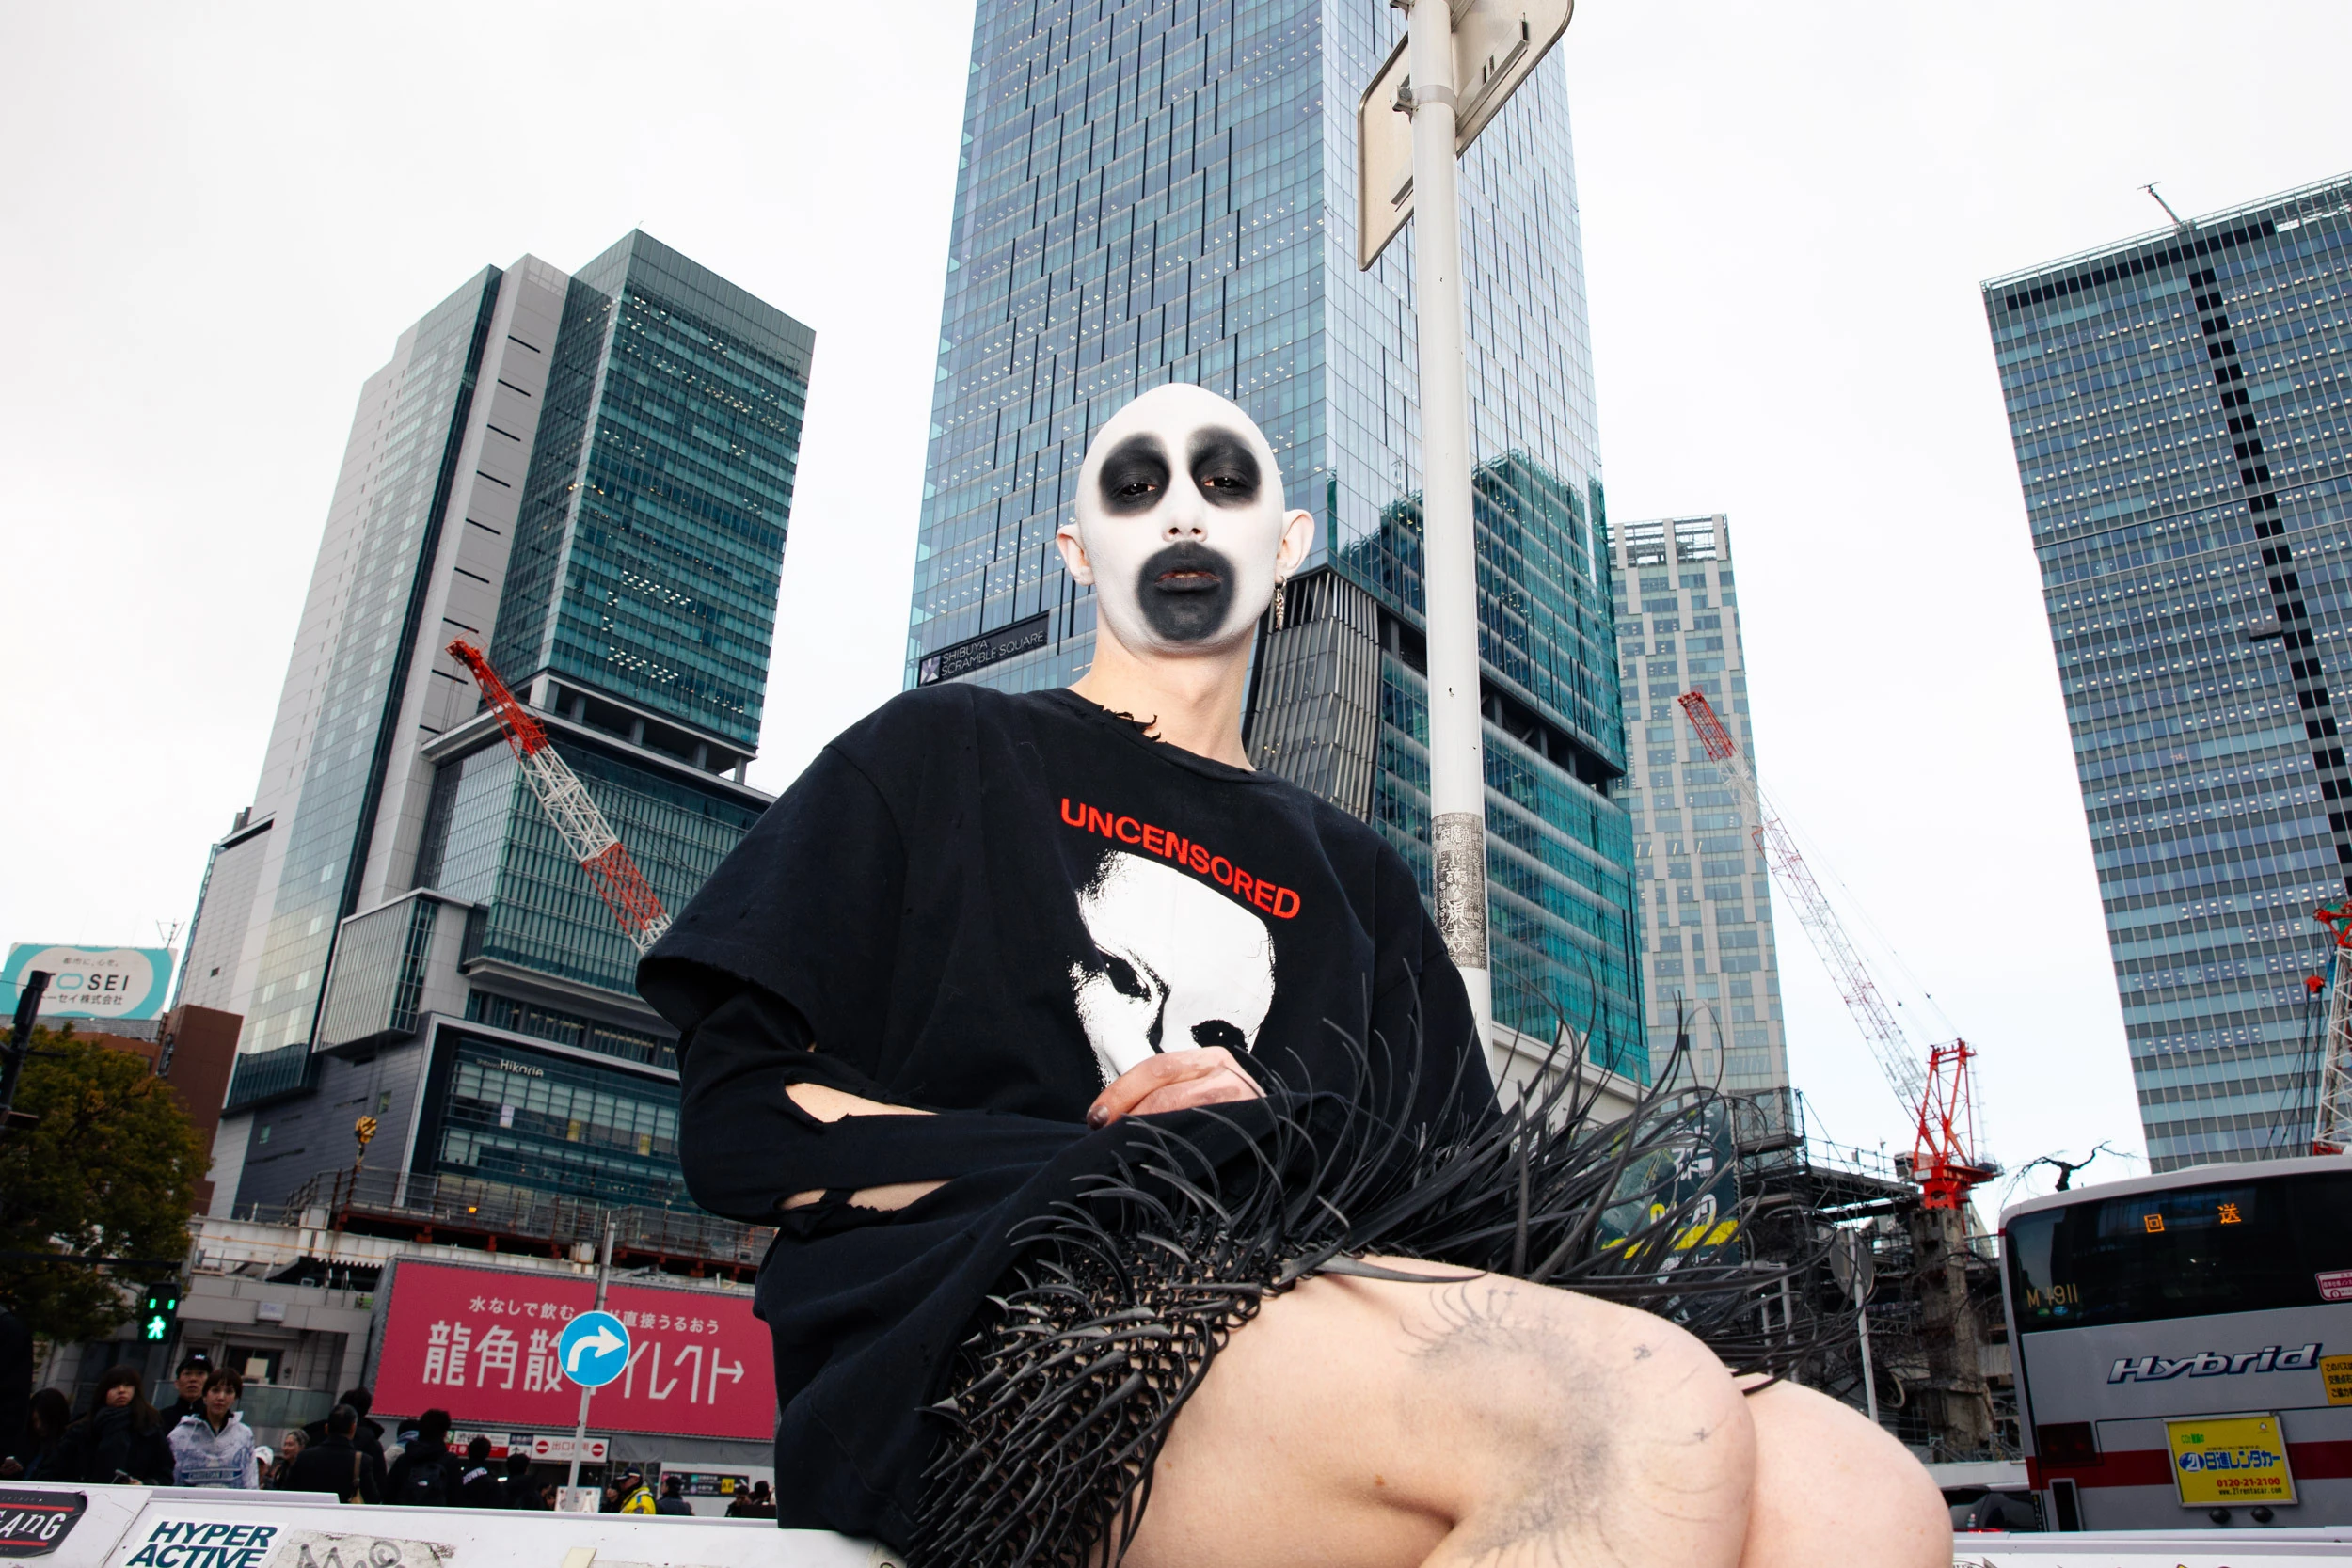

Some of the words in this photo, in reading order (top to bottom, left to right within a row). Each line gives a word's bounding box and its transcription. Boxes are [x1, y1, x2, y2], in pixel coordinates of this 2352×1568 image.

[941, 647, 997, 677] SCRAMBLE
[999, 630, 1044, 656] SQUARE
[942, 640, 989, 665] SHIBUYA
[1060, 797, 1302, 920] UNCENSORED
[49, 973, 130, 991] OSEI
[500, 1059, 544, 1078] Hikarie
[422, 1320, 744, 1405] 龍角散イレクト
[2107, 1342, 2323, 1385] Hybrid
[2204, 1449, 2281, 1471] 日進レンタカー
[2217, 1477, 2280, 1488] 0120-21-2100
[2218, 1487, 2282, 1496] www.21rentacar.com
[148, 1520, 278, 1547] HYPER
[125, 1543, 270, 1568] ACTIVE
